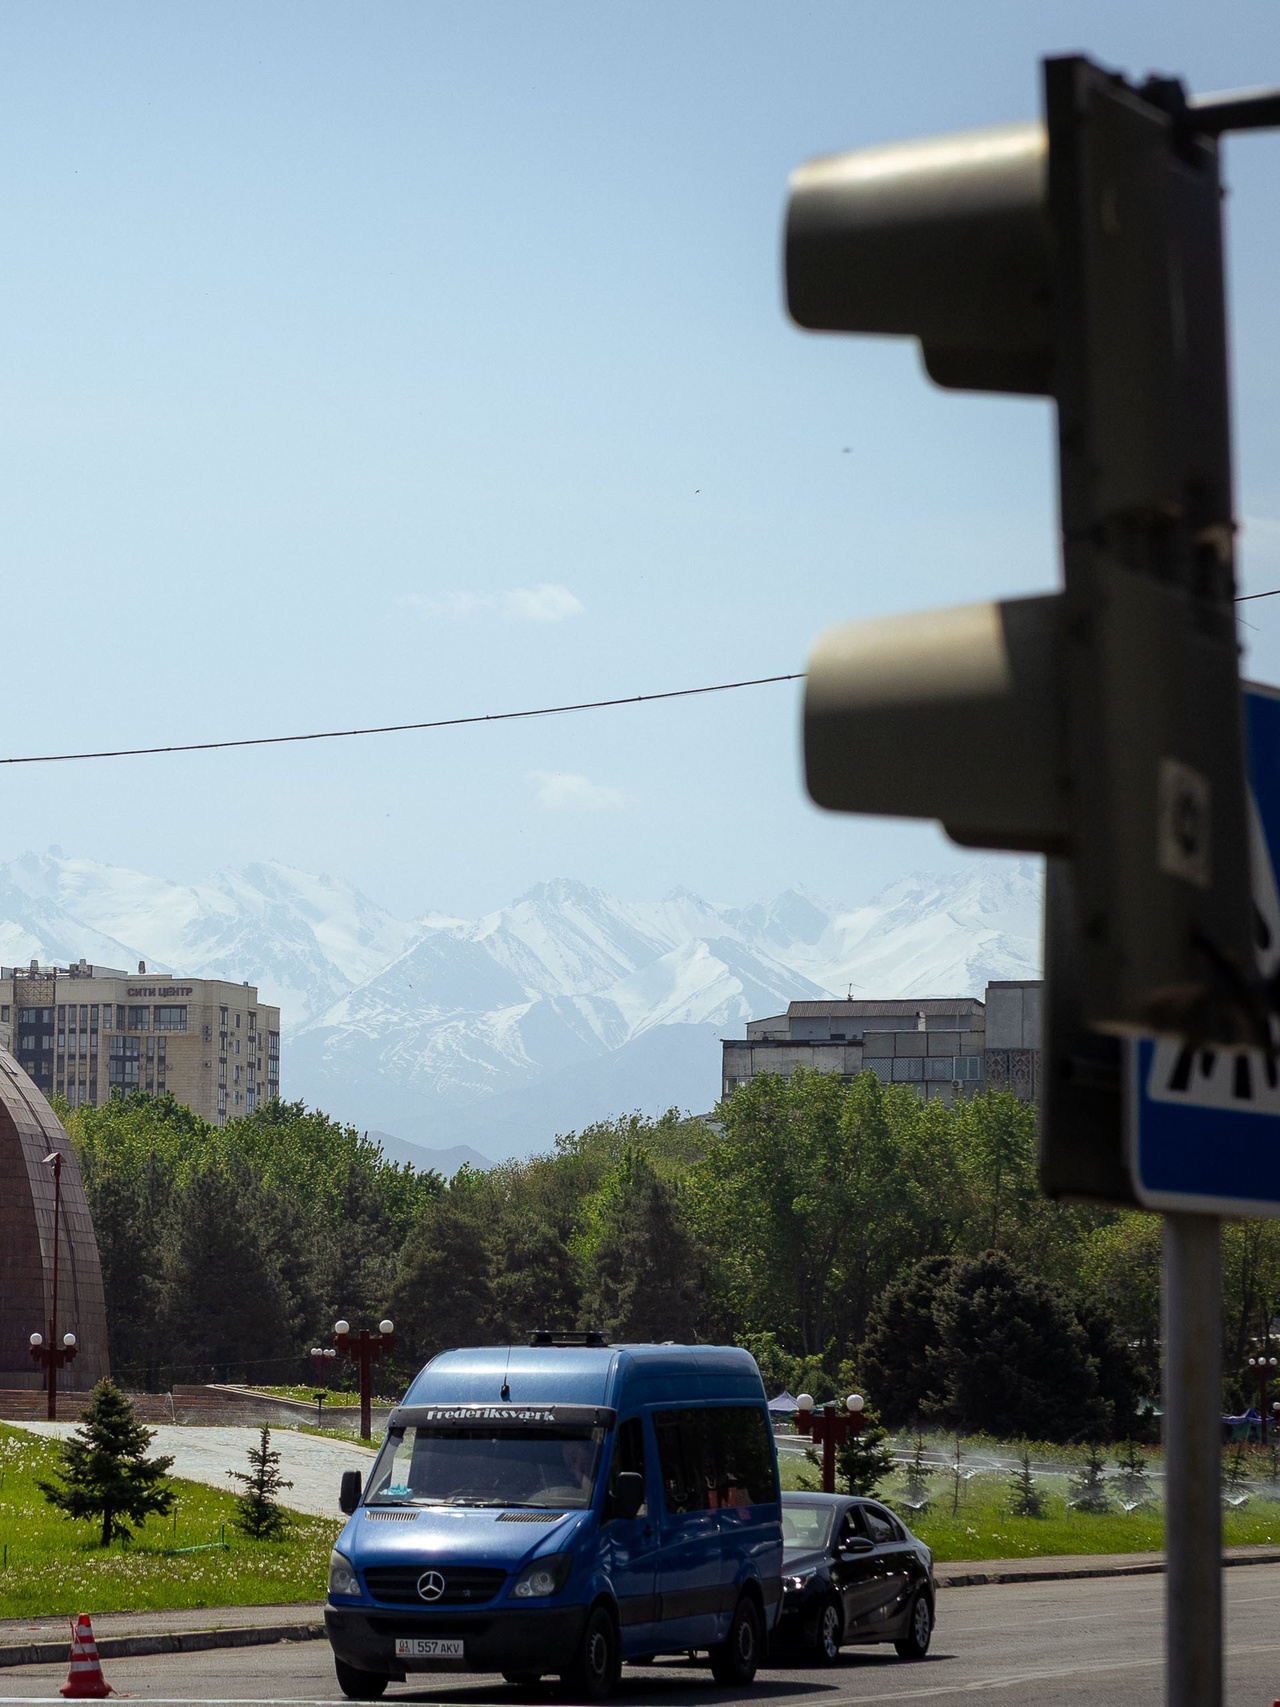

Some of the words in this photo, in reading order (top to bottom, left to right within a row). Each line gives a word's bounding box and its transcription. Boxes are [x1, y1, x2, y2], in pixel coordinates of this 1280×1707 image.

[127, 987, 156, 997] СИТИ
[158, 987, 193, 998] ЦЕНТР
[427, 1408, 556, 1421] Frederiksværk
[417, 1641, 438, 1653] 557
[440, 1643, 460, 1653] AKV
